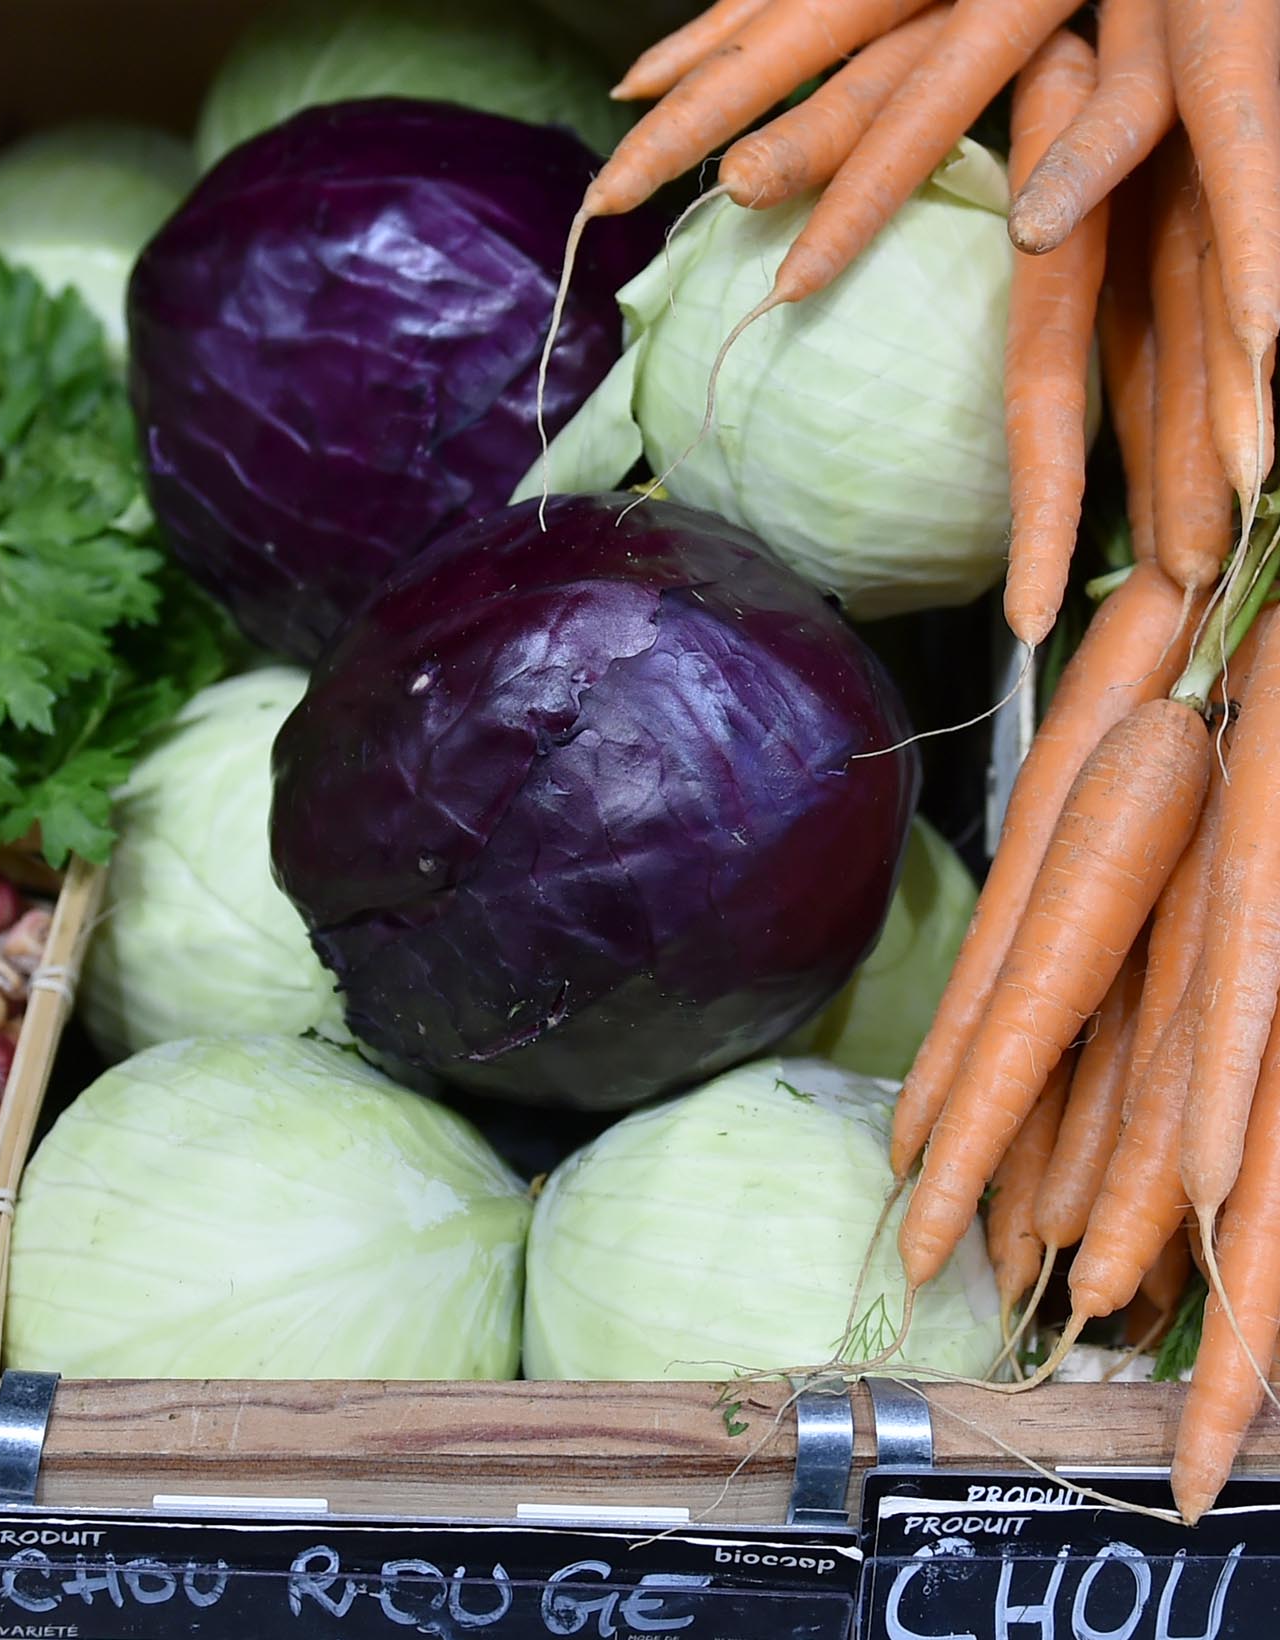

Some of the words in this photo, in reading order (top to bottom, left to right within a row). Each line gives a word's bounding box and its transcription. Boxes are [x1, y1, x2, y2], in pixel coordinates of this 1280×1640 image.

[968, 1485, 1092, 1506] PRODUIT
[904, 1516, 1032, 1536] PRODUIT
[714, 1547, 836, 1574] biocoop
[1, 1547, 228, 1613] CHOU
[885, 1536, 1247, 1640] CHOU
